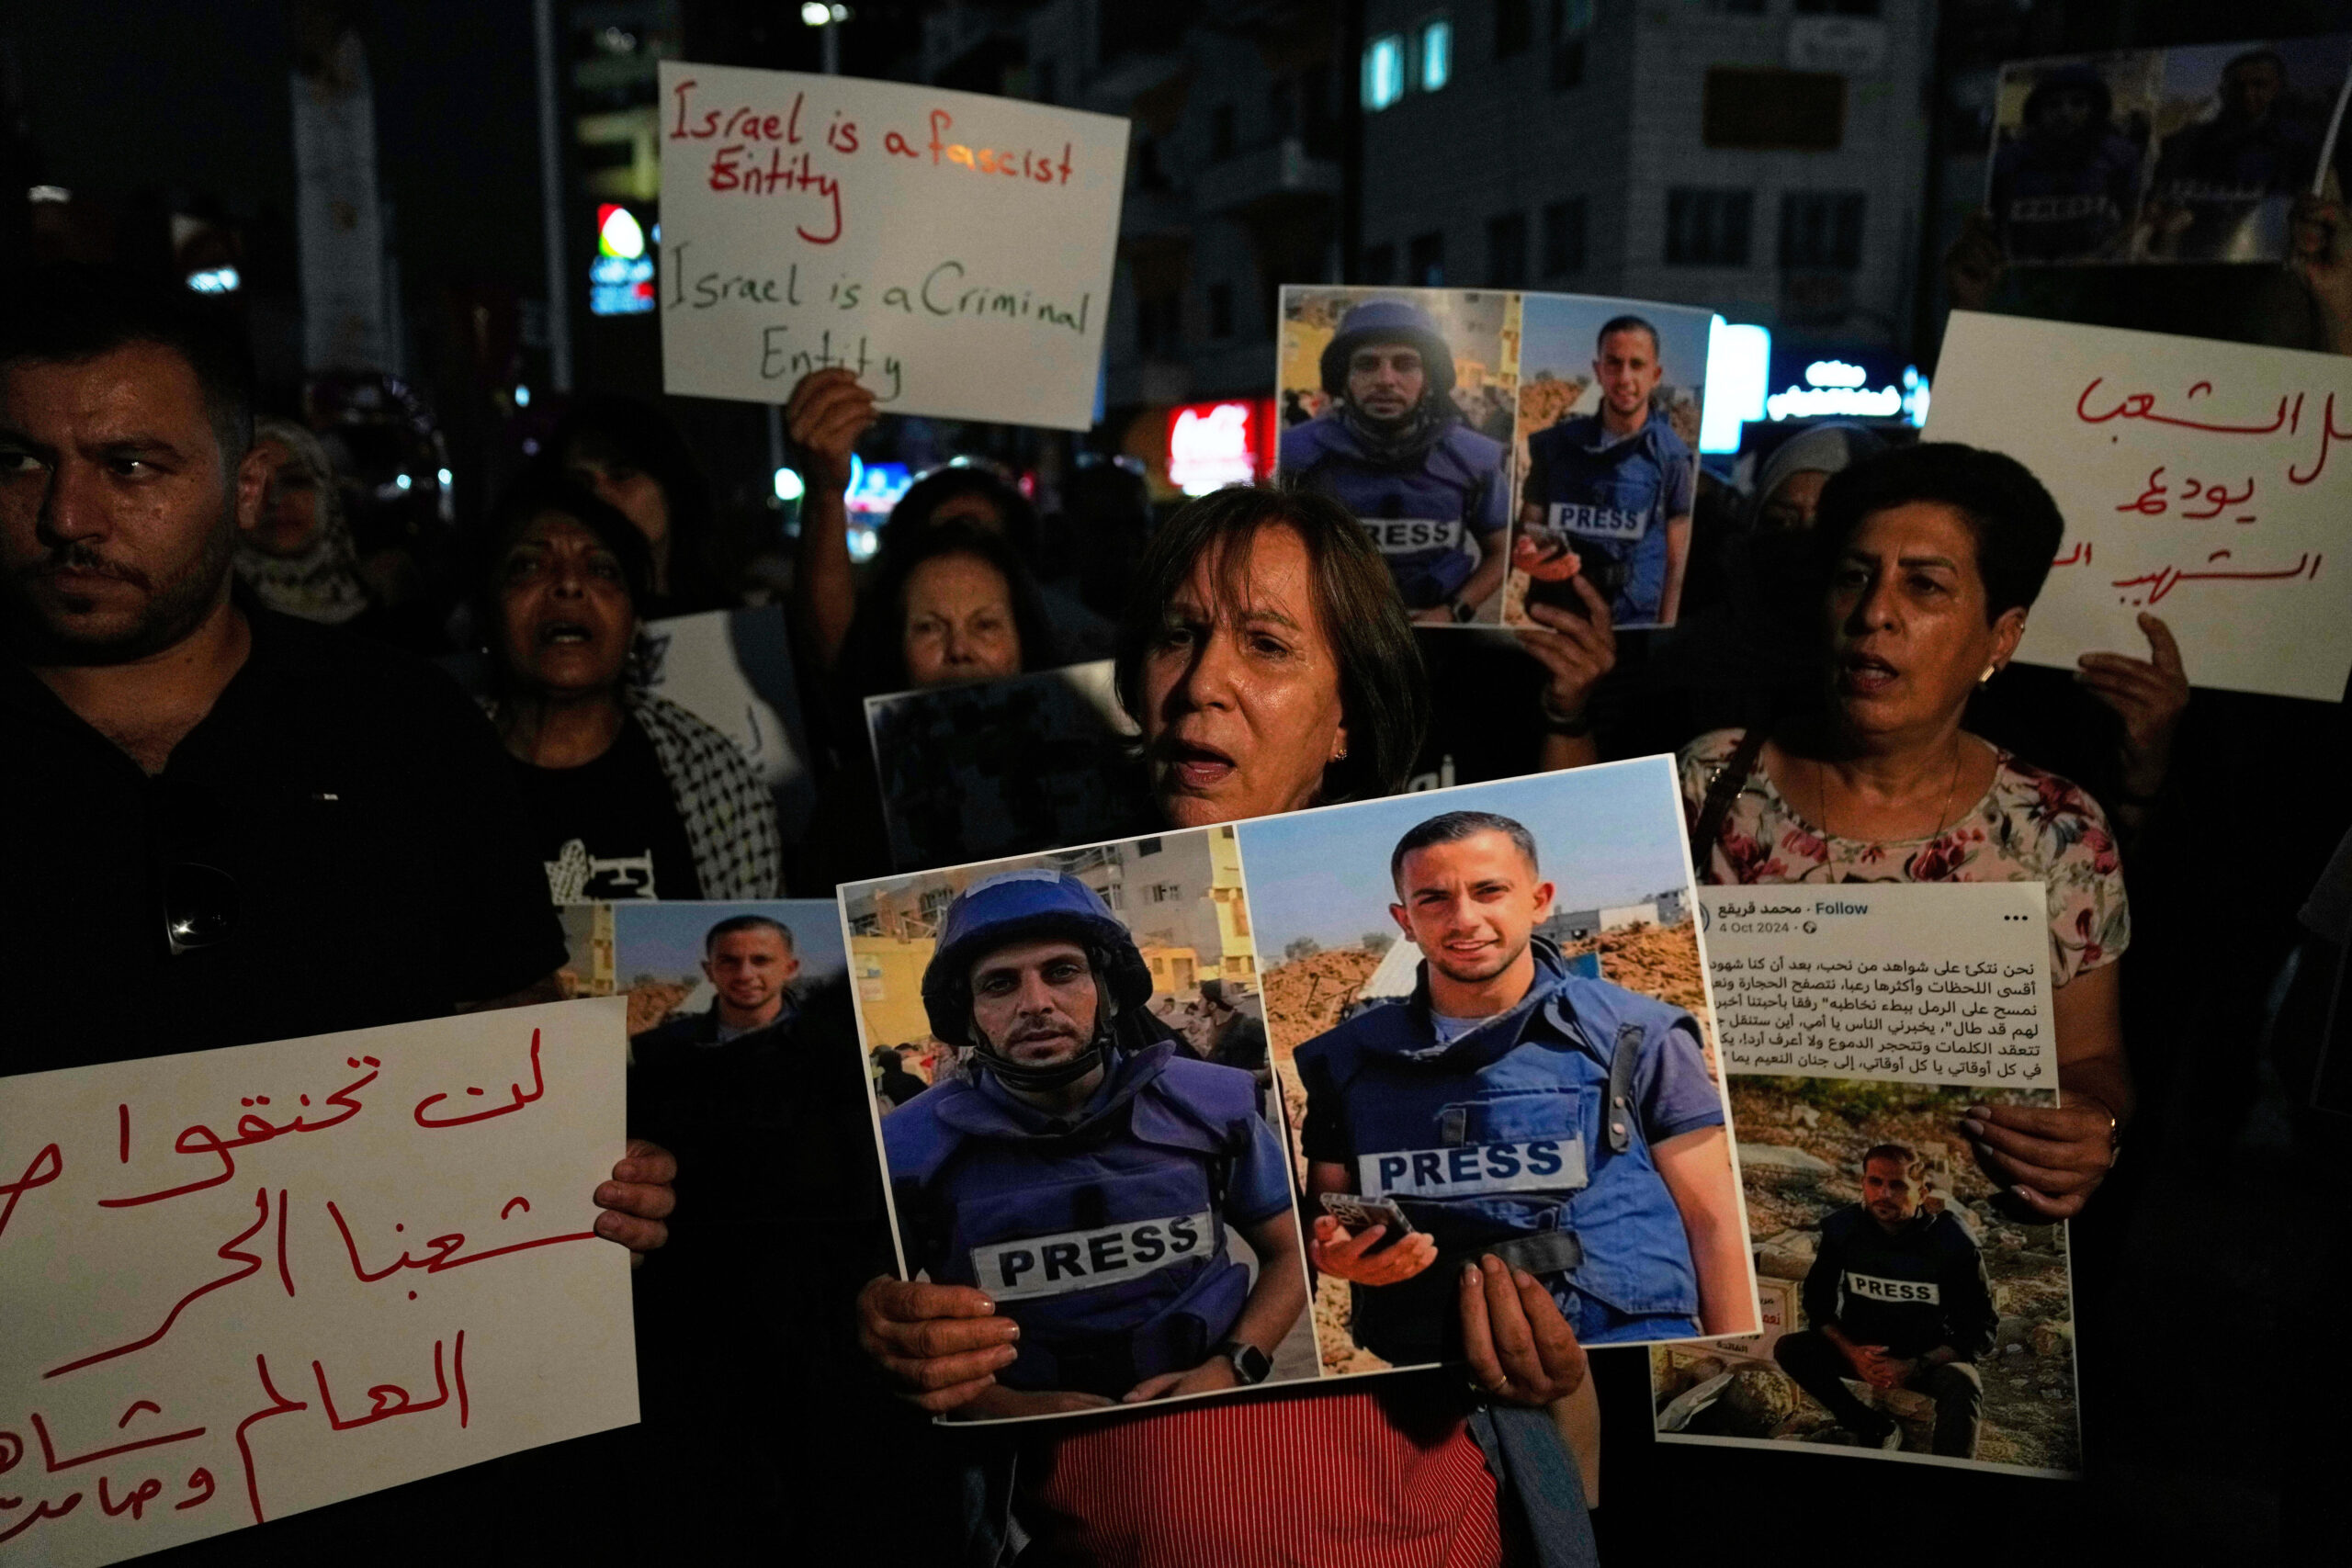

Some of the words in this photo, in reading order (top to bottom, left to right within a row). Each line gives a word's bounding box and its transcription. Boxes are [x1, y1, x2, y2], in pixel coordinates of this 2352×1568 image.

[670, 81, 804, 143] Israel
[828, 110, 859, 154] is
[885, 131, 919, 158] a
[929, 108, 1073, 186] fascist
[708, 145, 842, 245] Entity
[666, 242, 802, 310] Israel
[830, 273, 862, 310] is
[883, 288, 912, 312] a
[921, 261, 1091, 334] Criminal
[1561, 506, 1638, 530] PRESS
[1362, 523, 1450, 545] RESS
[1718, 901, 1756, 919] قريقع
[1759, 904, 1802, 915] محمد
[1815, 902, 1868, 915] Follow
[1719, 922, 1727, 933] 4
[1731, 922, 1753, 933] Oct
[1757, 922, 1789, 933] 2024
[1747, 957, 1765, 970] كنا
[1770, 955, 1783, 972] أن
[1788, 959, 1812, 971] بعد
[1858, 961, 1878, 974] من
[1883, 960, 1928, 976] شواهد
[1934, 961, 1961, 976] على
[1965, 962, 1997, 976] نتكئ
[2004, 964, 2034, 977] نحن
[1739, 976, 1787, 991] الحجارة
[1792, 980, 1836, 993] نتصفح
[1874, 977, 1923, 995] وأكثرها
[1928, 980, 1992, 995] اللحظات
[1997, 981, 2036, 998] أقسى
[1792, 995, 1818, 1011] رفقا
[1882, 998, 1913, 1013] ببطء
[1918, 999, 1956, 1016] الرمل
[1962, 1002, 1989, 1017] على
[1994, 1005, 2037, 1019] نمسح
[1729, 1014, 1772, 1028] ستنقل
[1775, 1013, 1794, 1030] أين
[1831, 1016, 1840, 1031] يا
[1845, 1017, 1883, 1032] الناس
[1888, 1020, 1936, 1035] يخبرني
[1987, 1022, 2007, 1035] قد
[1769, 1032, 1803, 1046] أعرف
[2012, 1023, 2039, 1040] لهم
[1807, 1034, 1824, 1049] ولا
[1827, 1036, 1873, 1051] الدموع
[1877, 1041, 1930, 1055] وتتحجر
[1935, 1040, 1992, 1055] الكلمات
[1997, 1044, 2041, 1056] تتعقد
[1732, 1051, 1749, 1065] يما
[1755, 1052, 1793, 1067] النعيم
[1798, 1054, 1829, 1067] جنان
[1833, 1055, 1855, 1070] إلى
[1909, 1058, 1928, 1074] كل
[1933, 1059, 1943, 1076] يا
[1948, 1060, 1991, 1077] أوقاتي
[1997, 1063, 2017, 1078] كل
[2022, 1066, 2042, 1080] في
[413, 1028, 544, 1129] لن
[98, 1055, 381, 1208] تخنقوا
[1378, 1140, 1564, 1191] PRESS
[328, 1196, 597, 1302] شعبنا
[997, 1216, 1199, 1287] PRESS
[43, 1186, 296, 1380] الحر
[1855, 1276, 1932, 1301] PRESS
[235, 1329, 469, 1524] العالم
